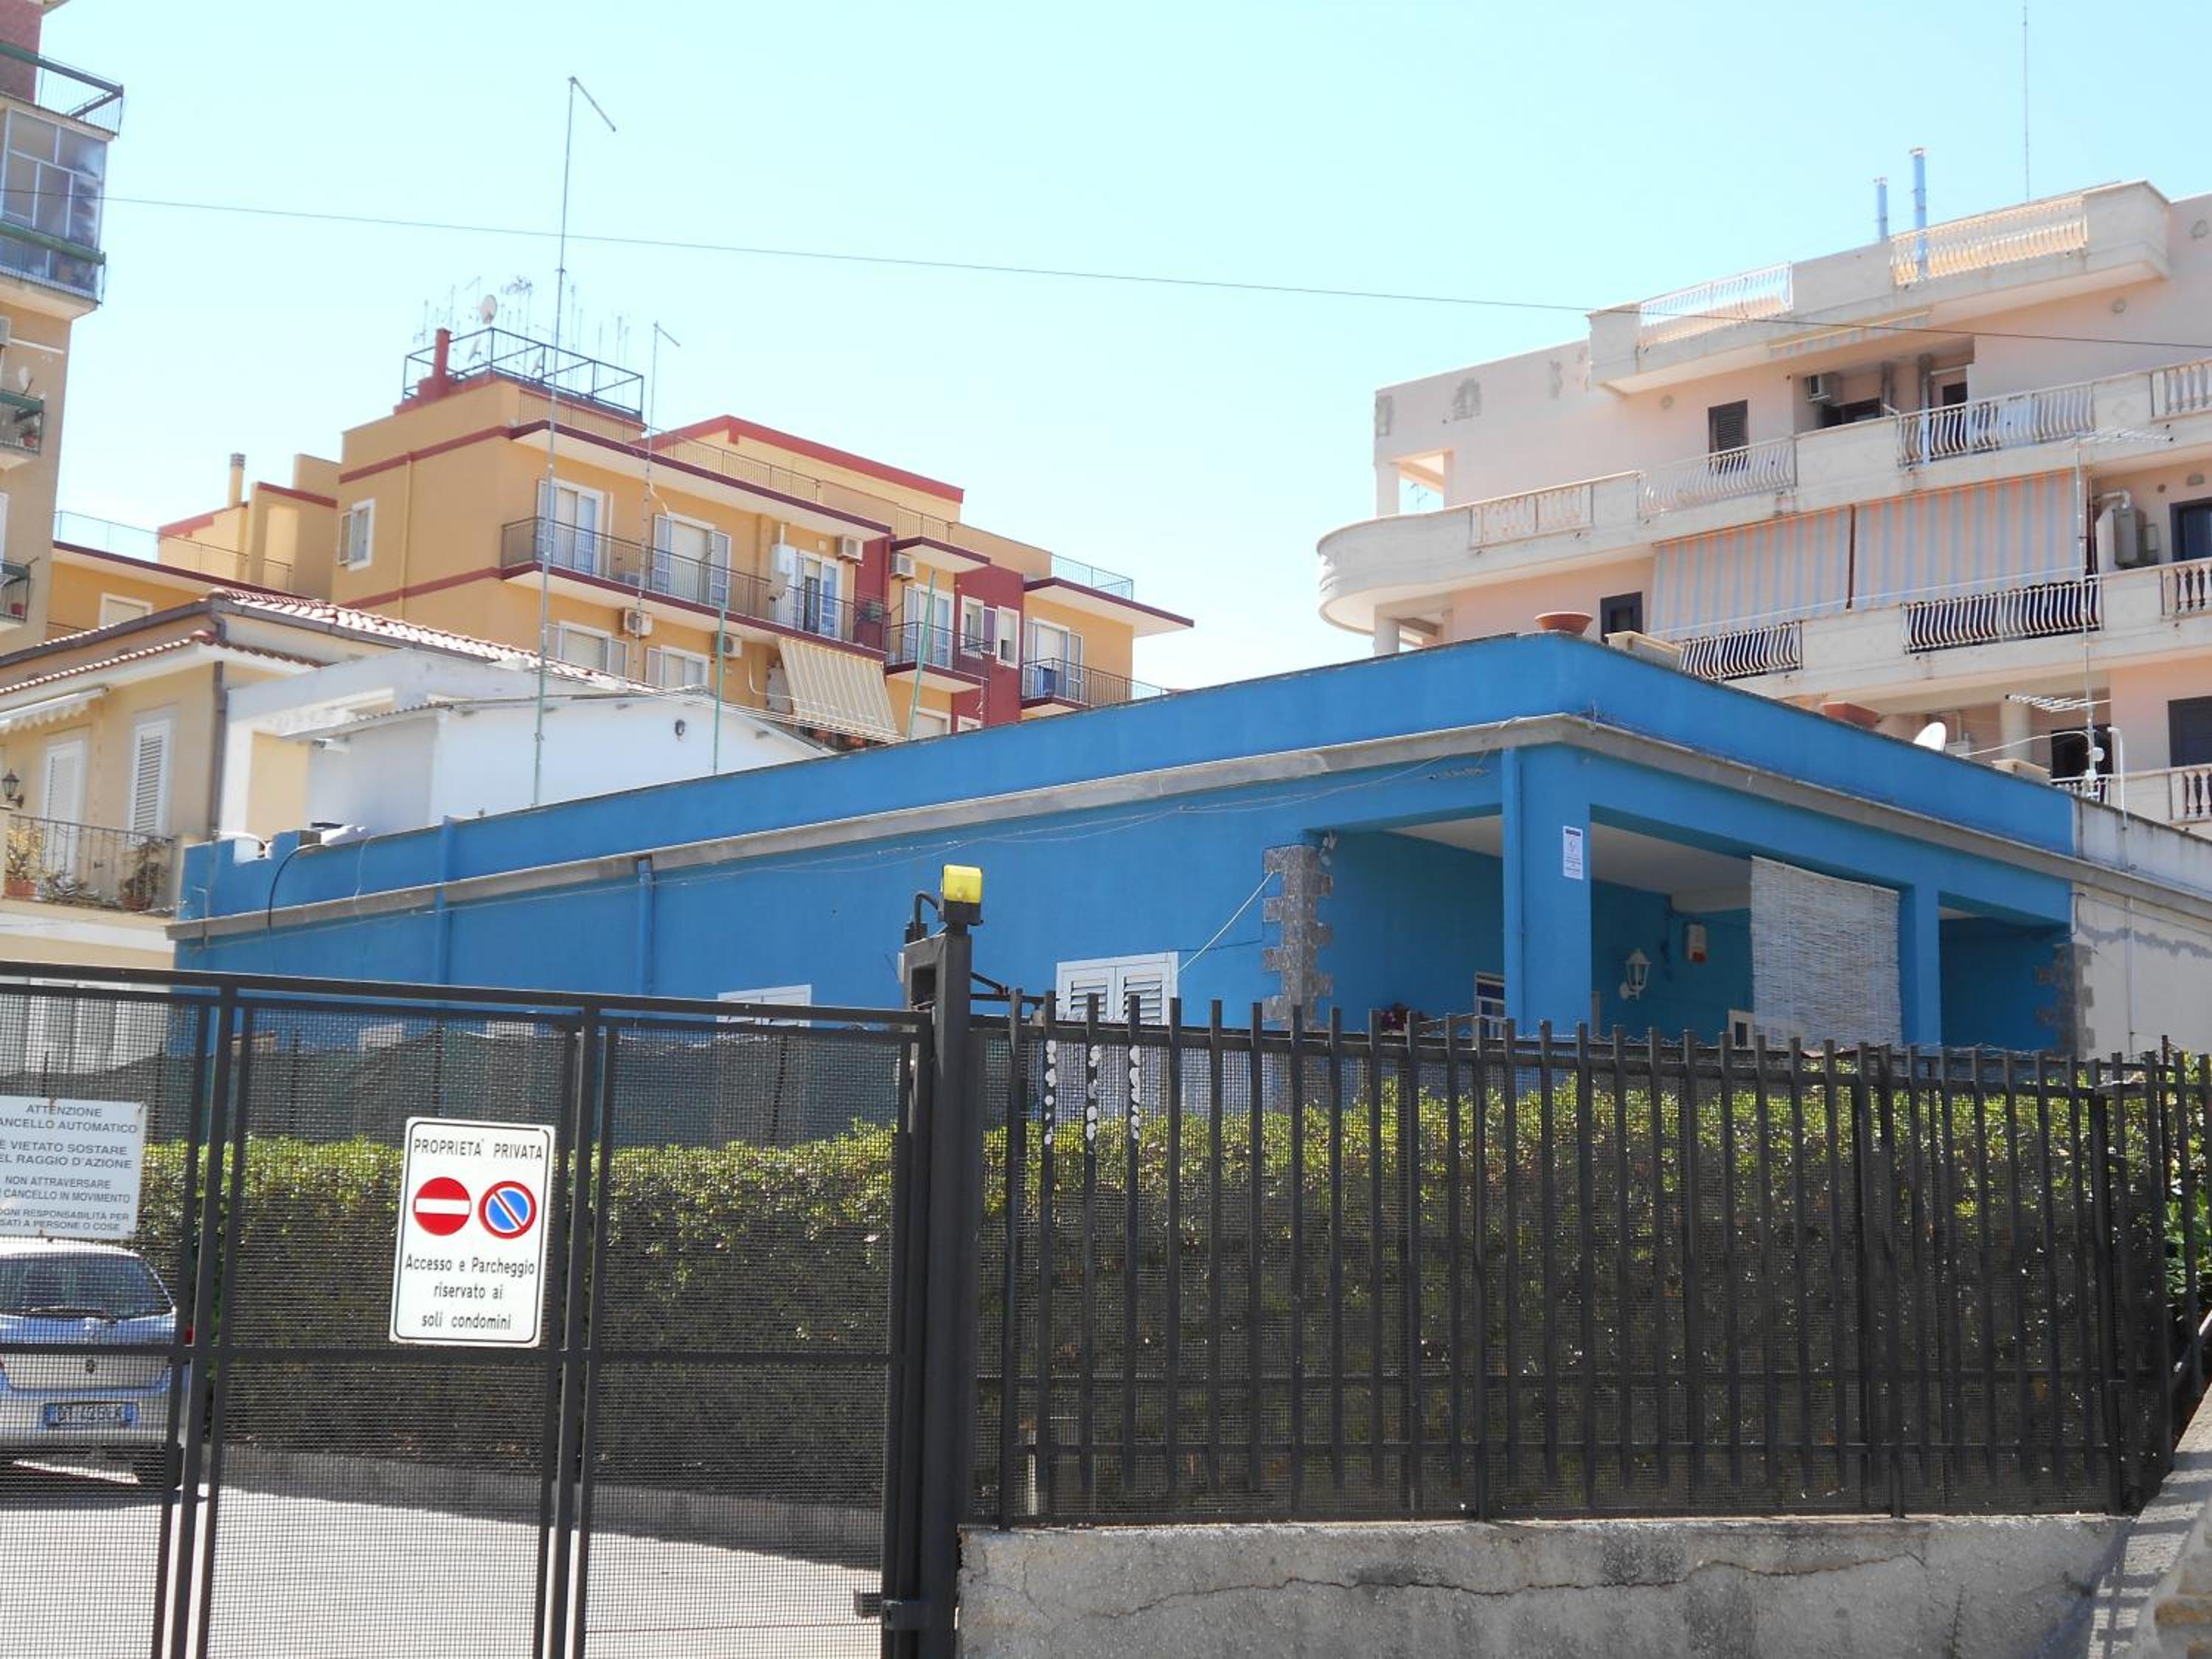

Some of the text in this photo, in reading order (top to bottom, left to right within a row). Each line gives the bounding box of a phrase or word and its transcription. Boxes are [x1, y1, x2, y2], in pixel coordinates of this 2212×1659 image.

[26, 1104, 102, 1117] ATTENZIONE
[58, 1121, 137, 1133] AUTOMATICO
[11, 1141, 63, 1152] VIETATO
[67, 1144, 128, 1155] SOSTARE
[493, 1143, 543, 1160] PRIVATA
[16, 1155, 68, 1166] RAGGIO
[72, 1157, 133, 1169] D'AZIONE
[5, 1176, 111, 1189] NON ATTRAVERSARE
[4, 1189, 131, 1204] CANCELLO IN MOVIMENTO
[109, 1213, 129, 1221] PER
[33, 1220, 79, 1230] PERSONE
[83, 1222, 90, 1230] O
[93, 1222, 119, 1231] COSE
[405, 1254, 535, 1278] Accesso e Parcheggio
[434, 1281, 504, 1300] riservato ai
[421, 1312, 511, 1330] soli condomini
